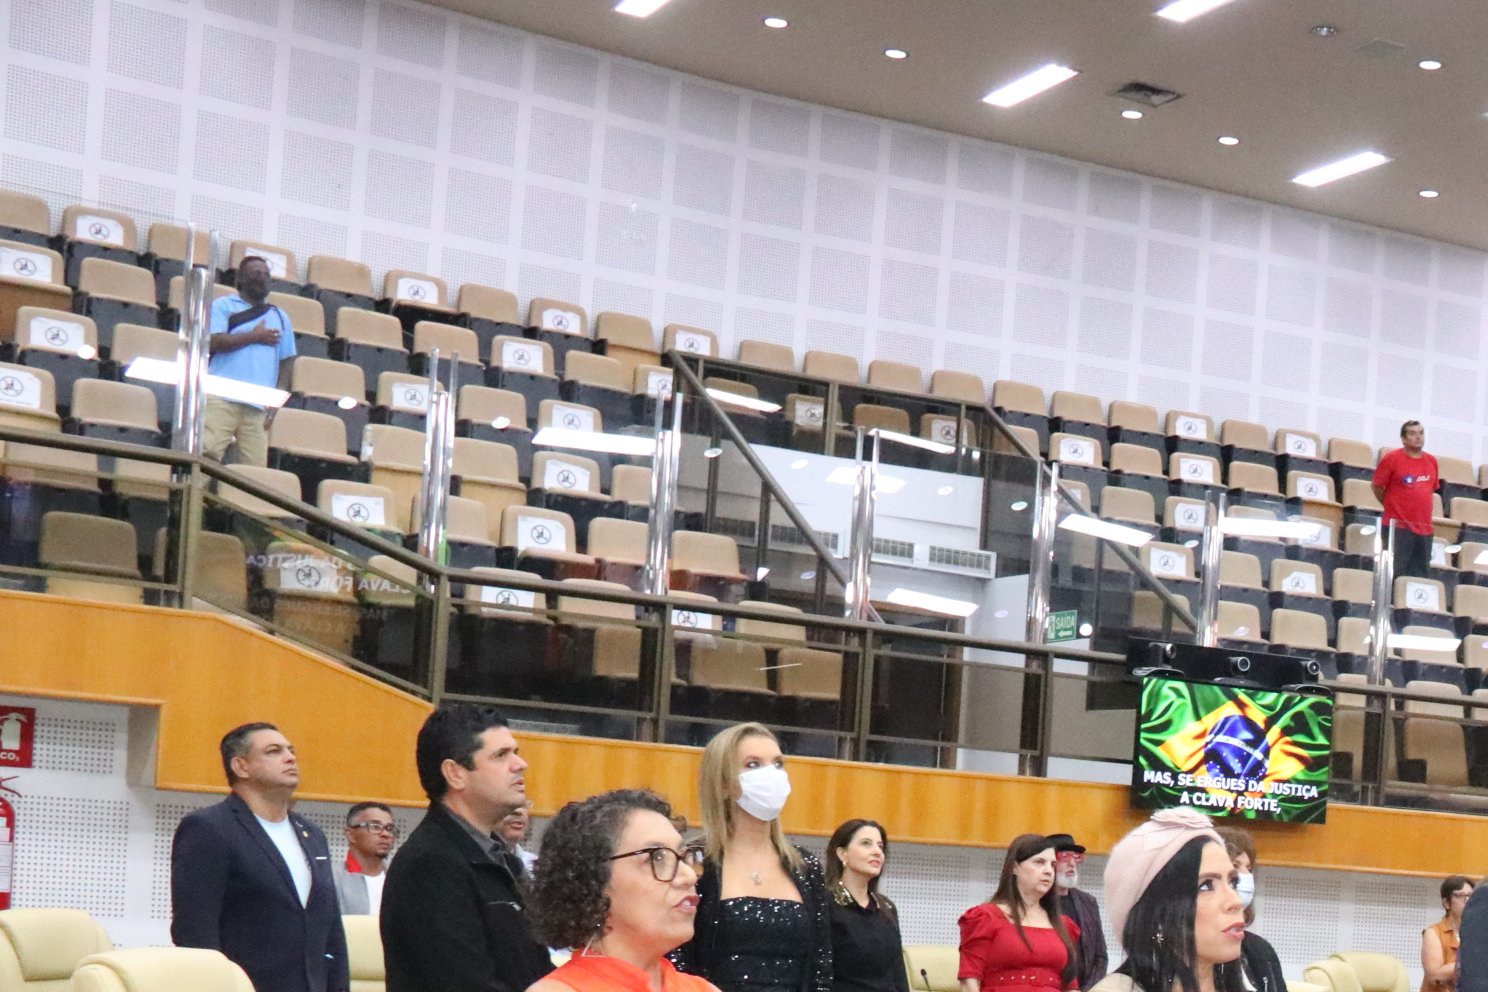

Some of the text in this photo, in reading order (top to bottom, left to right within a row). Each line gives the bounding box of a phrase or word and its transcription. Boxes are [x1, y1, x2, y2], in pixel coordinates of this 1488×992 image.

[1143, 770, 1319, 800] MAS, SE ERGUES DA JUSTIÇA
[1179, 791, 1282, 815] A CLAVA FORTE,
